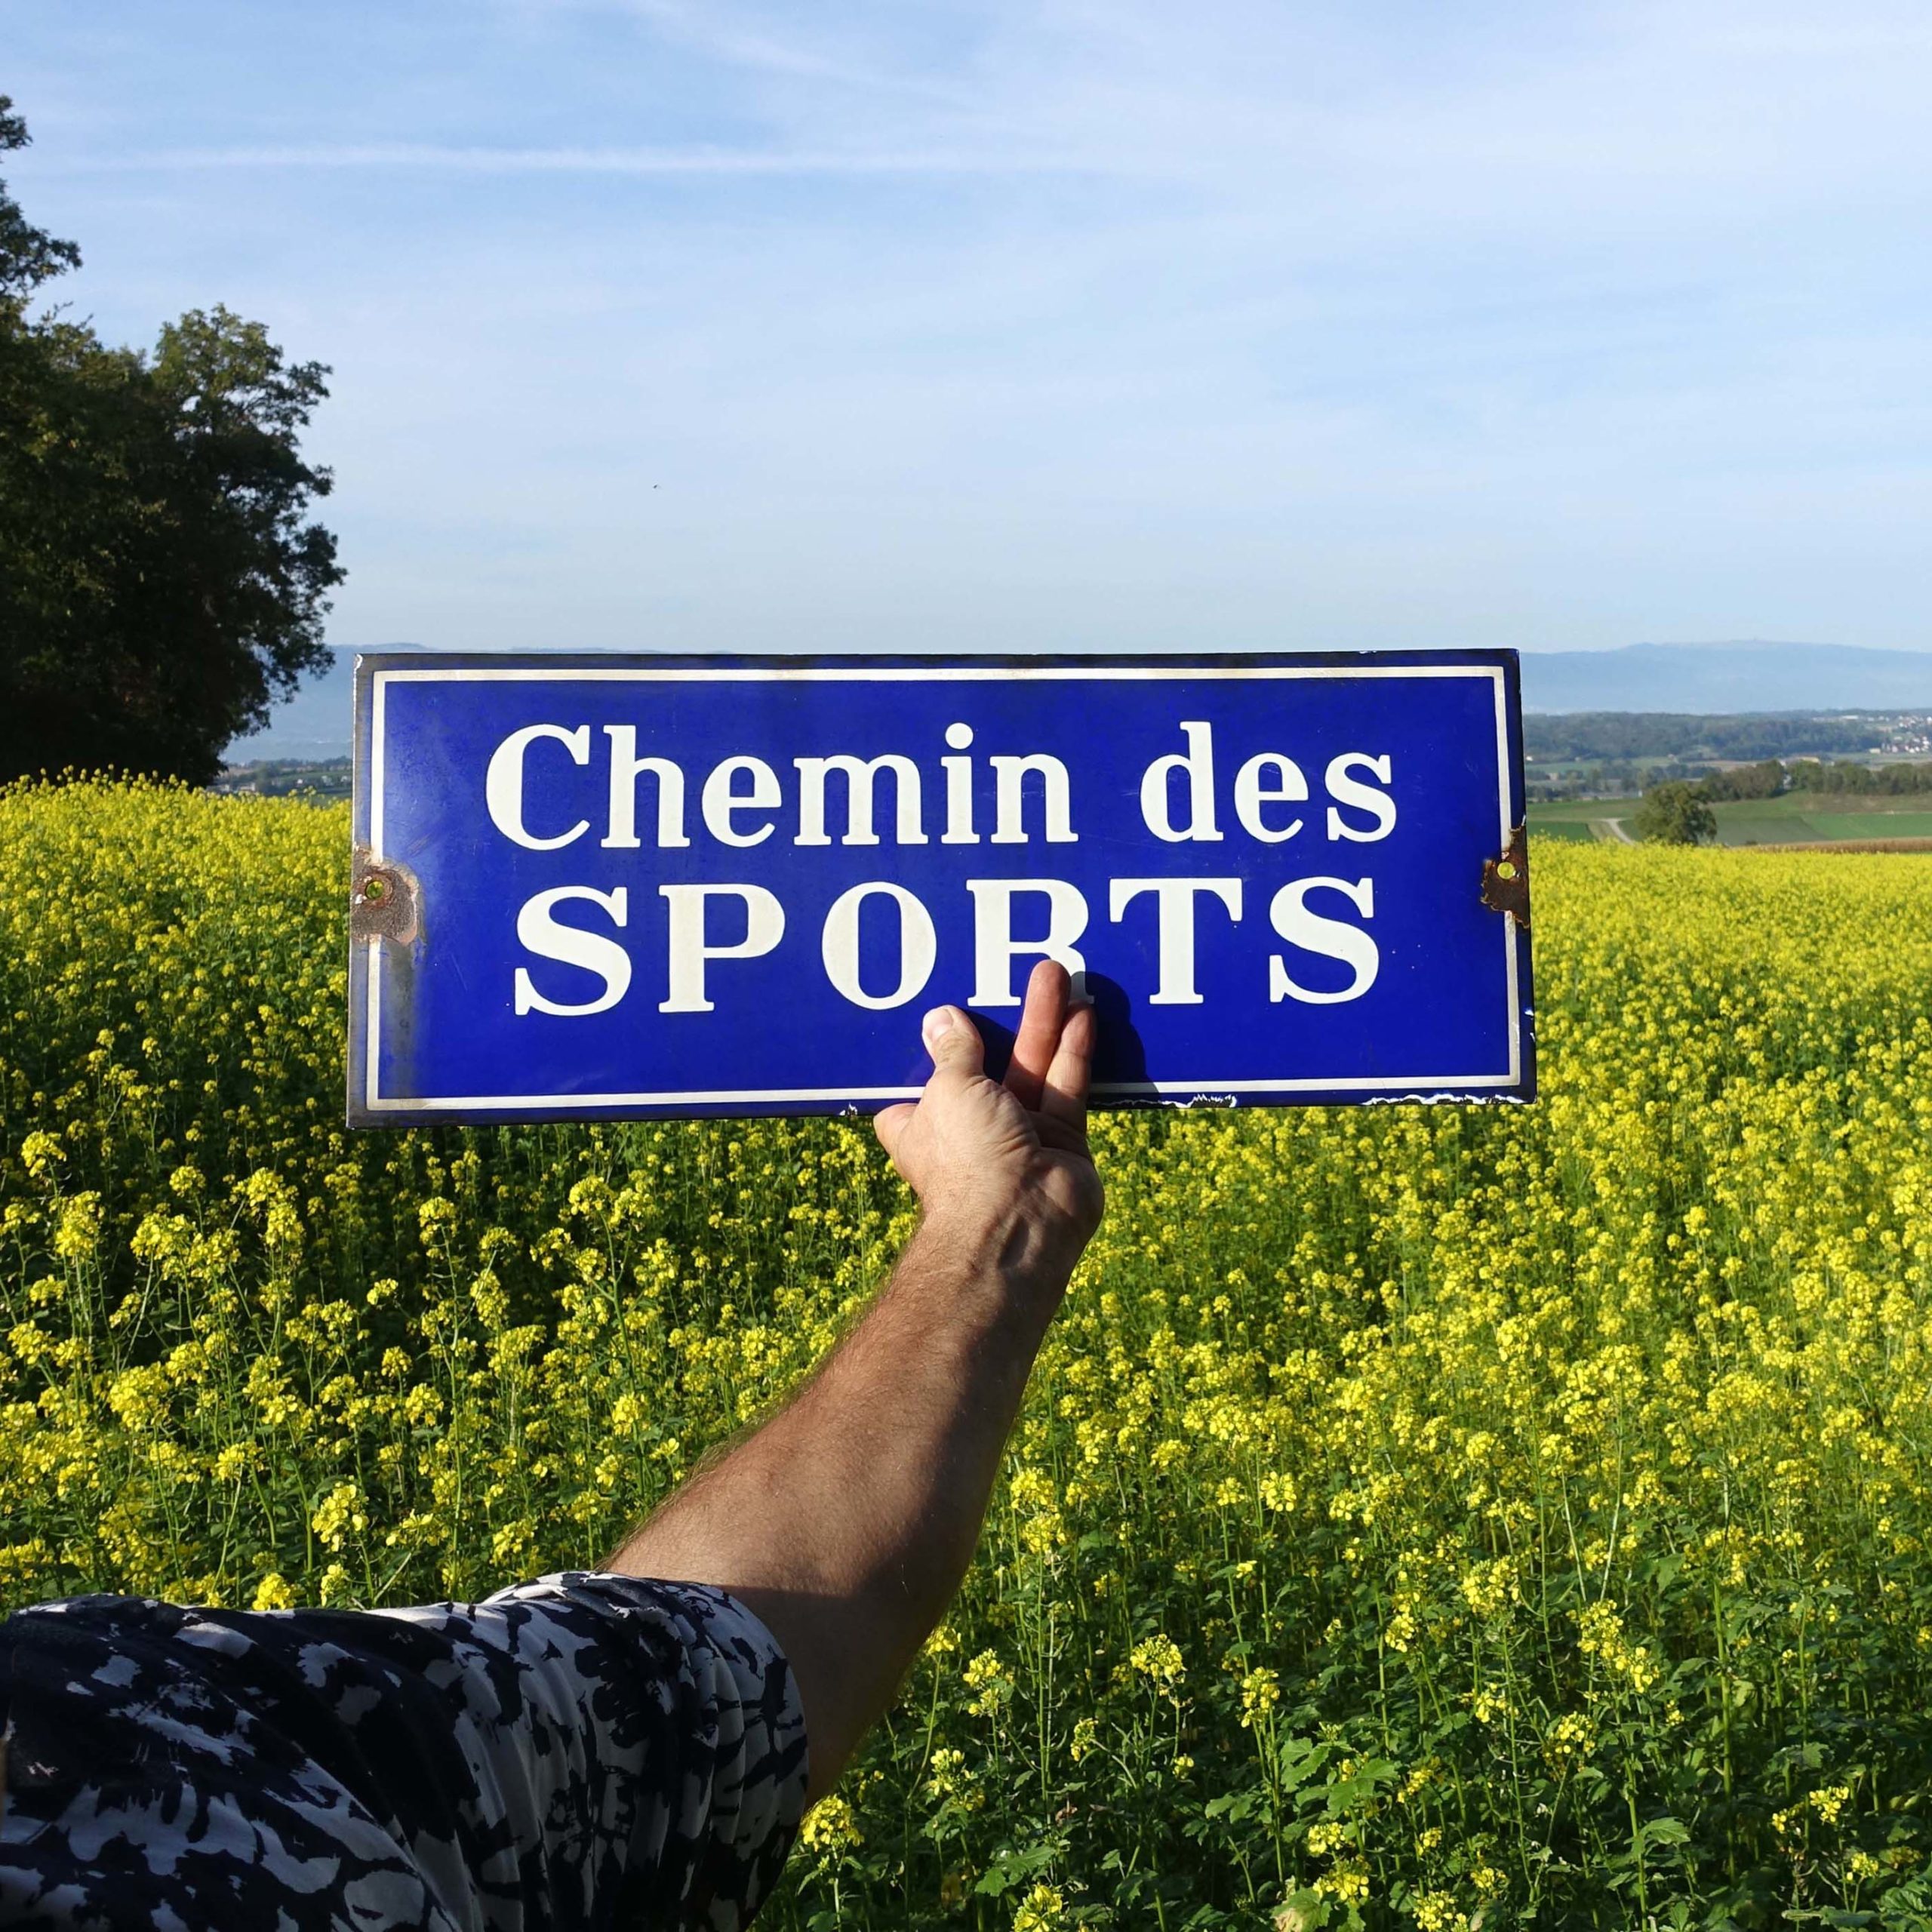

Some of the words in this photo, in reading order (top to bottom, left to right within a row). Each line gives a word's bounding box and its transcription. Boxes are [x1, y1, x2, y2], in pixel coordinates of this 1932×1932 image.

[485, 722, 1079, 851] Chemin
[1140, 721, 1398, 843] des
[514, 876, 1380, 1017] SPORTS
